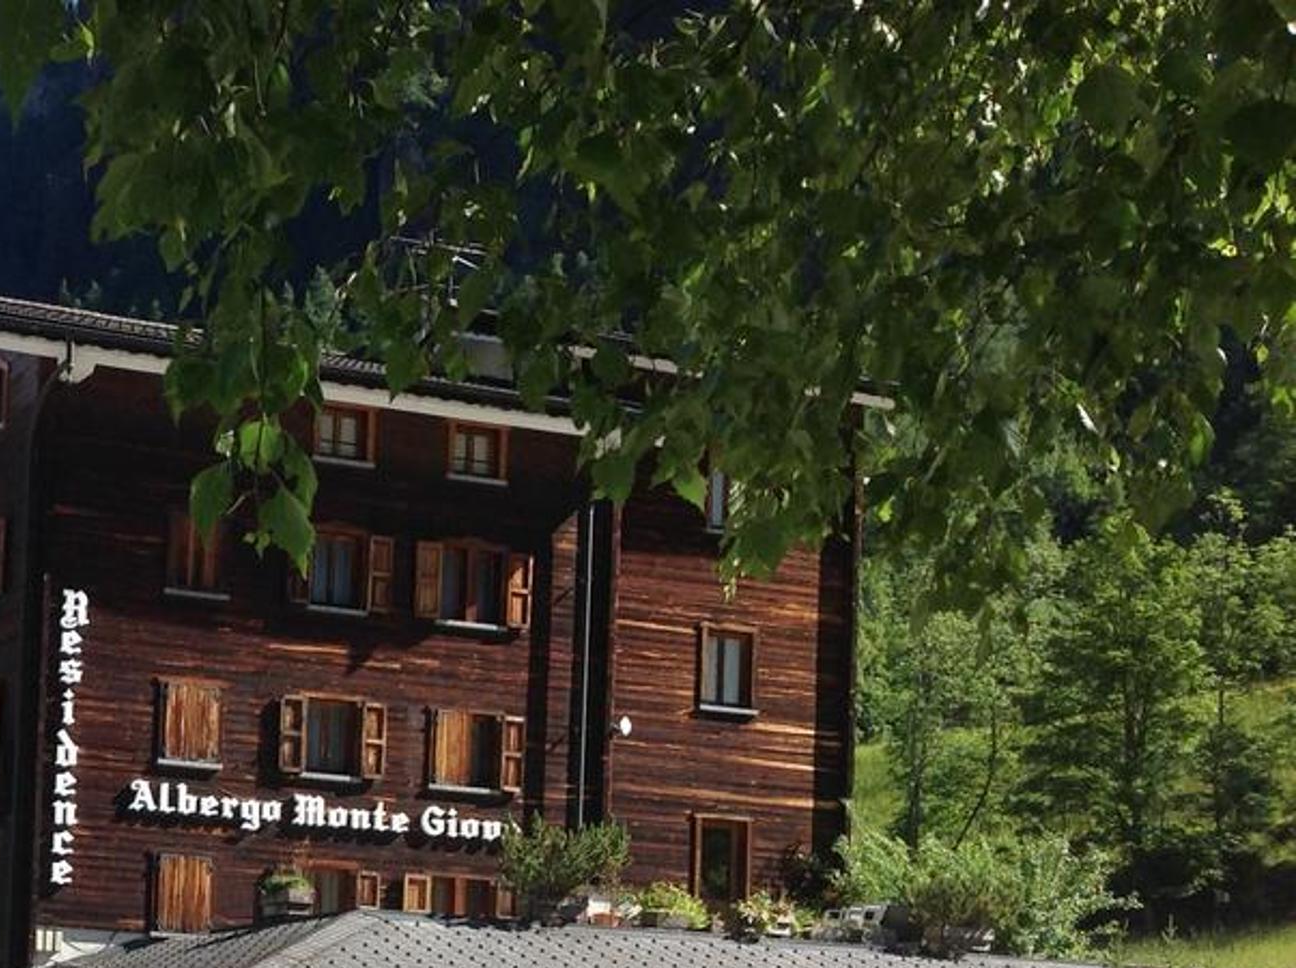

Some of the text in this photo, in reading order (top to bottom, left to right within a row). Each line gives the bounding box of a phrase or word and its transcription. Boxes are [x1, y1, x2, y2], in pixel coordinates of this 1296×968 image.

[50, 588, 90, 885] Residence
[128, 778, 520, 842] Albergo Monte Giov
